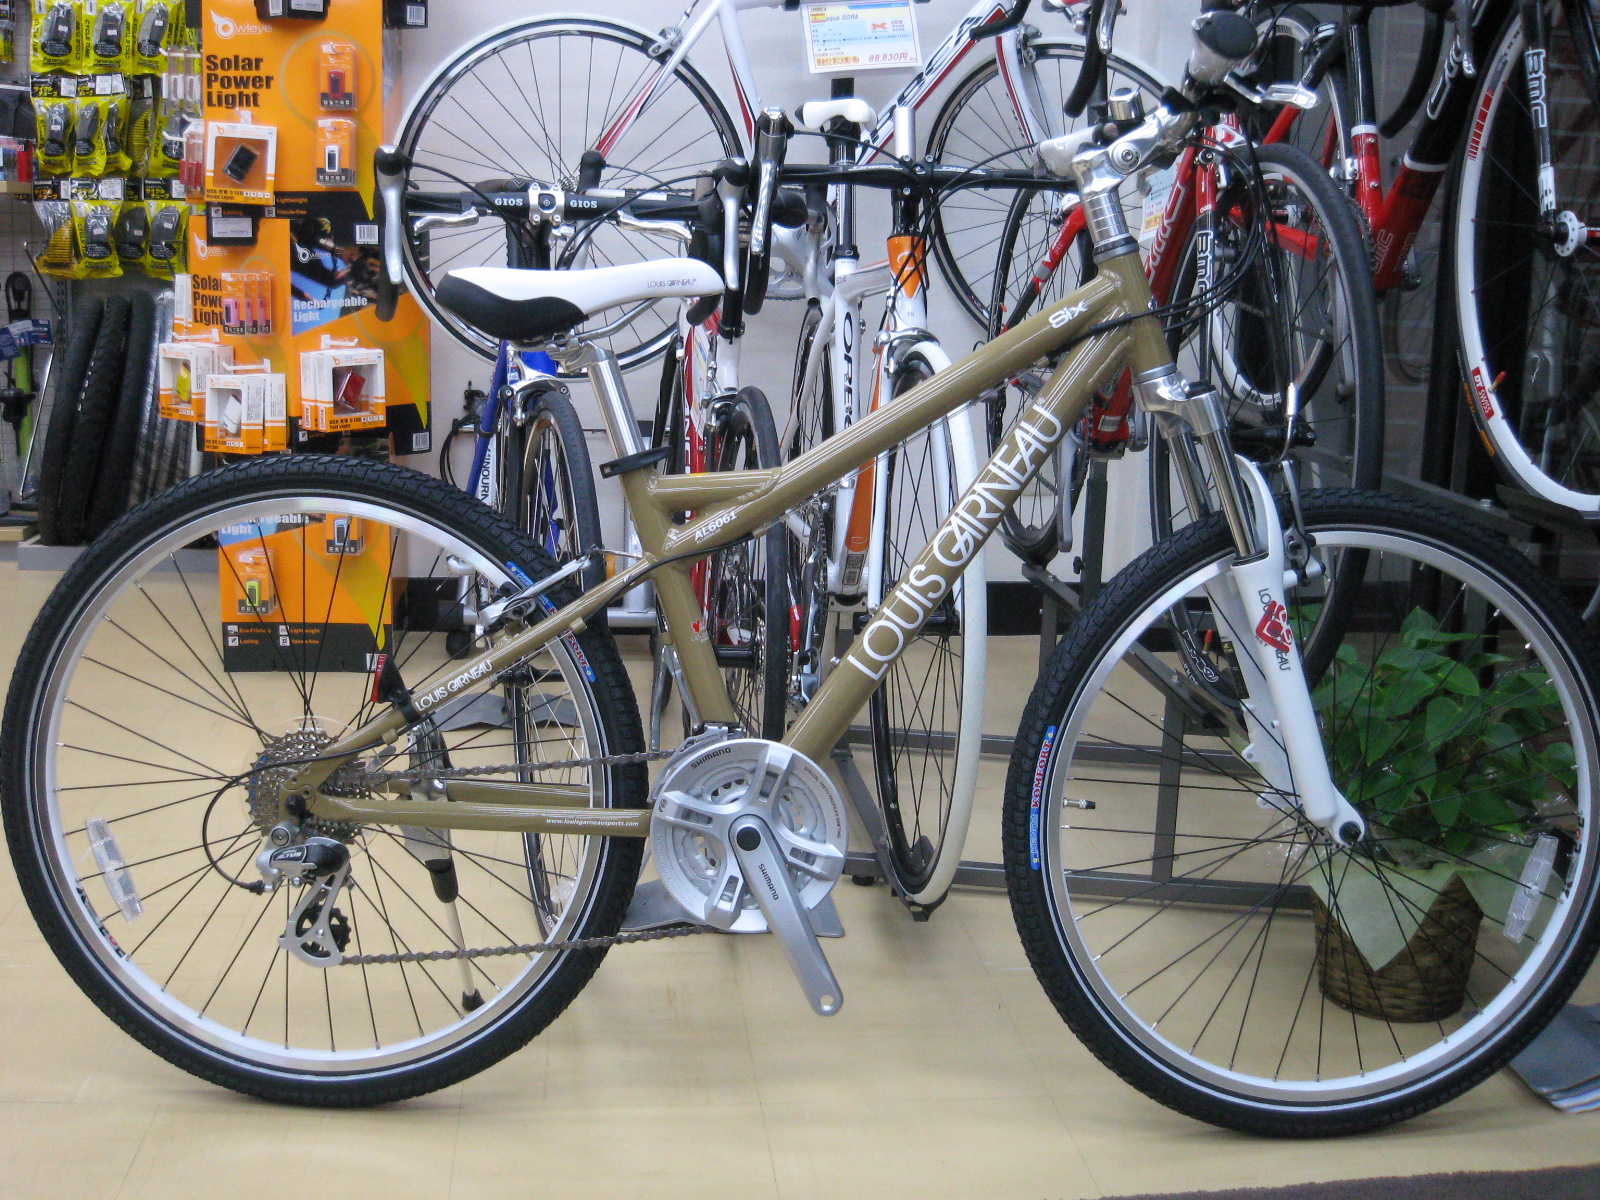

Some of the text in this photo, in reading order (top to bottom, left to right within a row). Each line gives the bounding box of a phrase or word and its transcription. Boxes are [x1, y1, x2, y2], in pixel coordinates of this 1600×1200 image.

[206, 54, 264, 71] Solar
[206, 73, 275, 90] Power
[206, 91, 260, 109] Light
[494, 198, 524, 206] GIOS
[570, 200, 598, 209] GIOS
[647, 280, 666, 288] LOUIS
[294, 296, 368, 311] Rechargeable
[294, 311, 321, 324] Light
[1477, 388, 1492, 415] SWISS
[694, 511, 738, 541] AL6061
[847, 402, 1063, 681] LOUIS GARNEAU
[415, 659, 494, 712] LOUIS GARNEAU
[690, 747, 731, 769] SHIMANO
[1031, 741, 1052, 809] KOMFORT
[546, 818, 640, 828] www.louisgarneausports.com
[276, 851, 303, 860] ALTUS
[758, 863, 779, 901] SHIMANO
